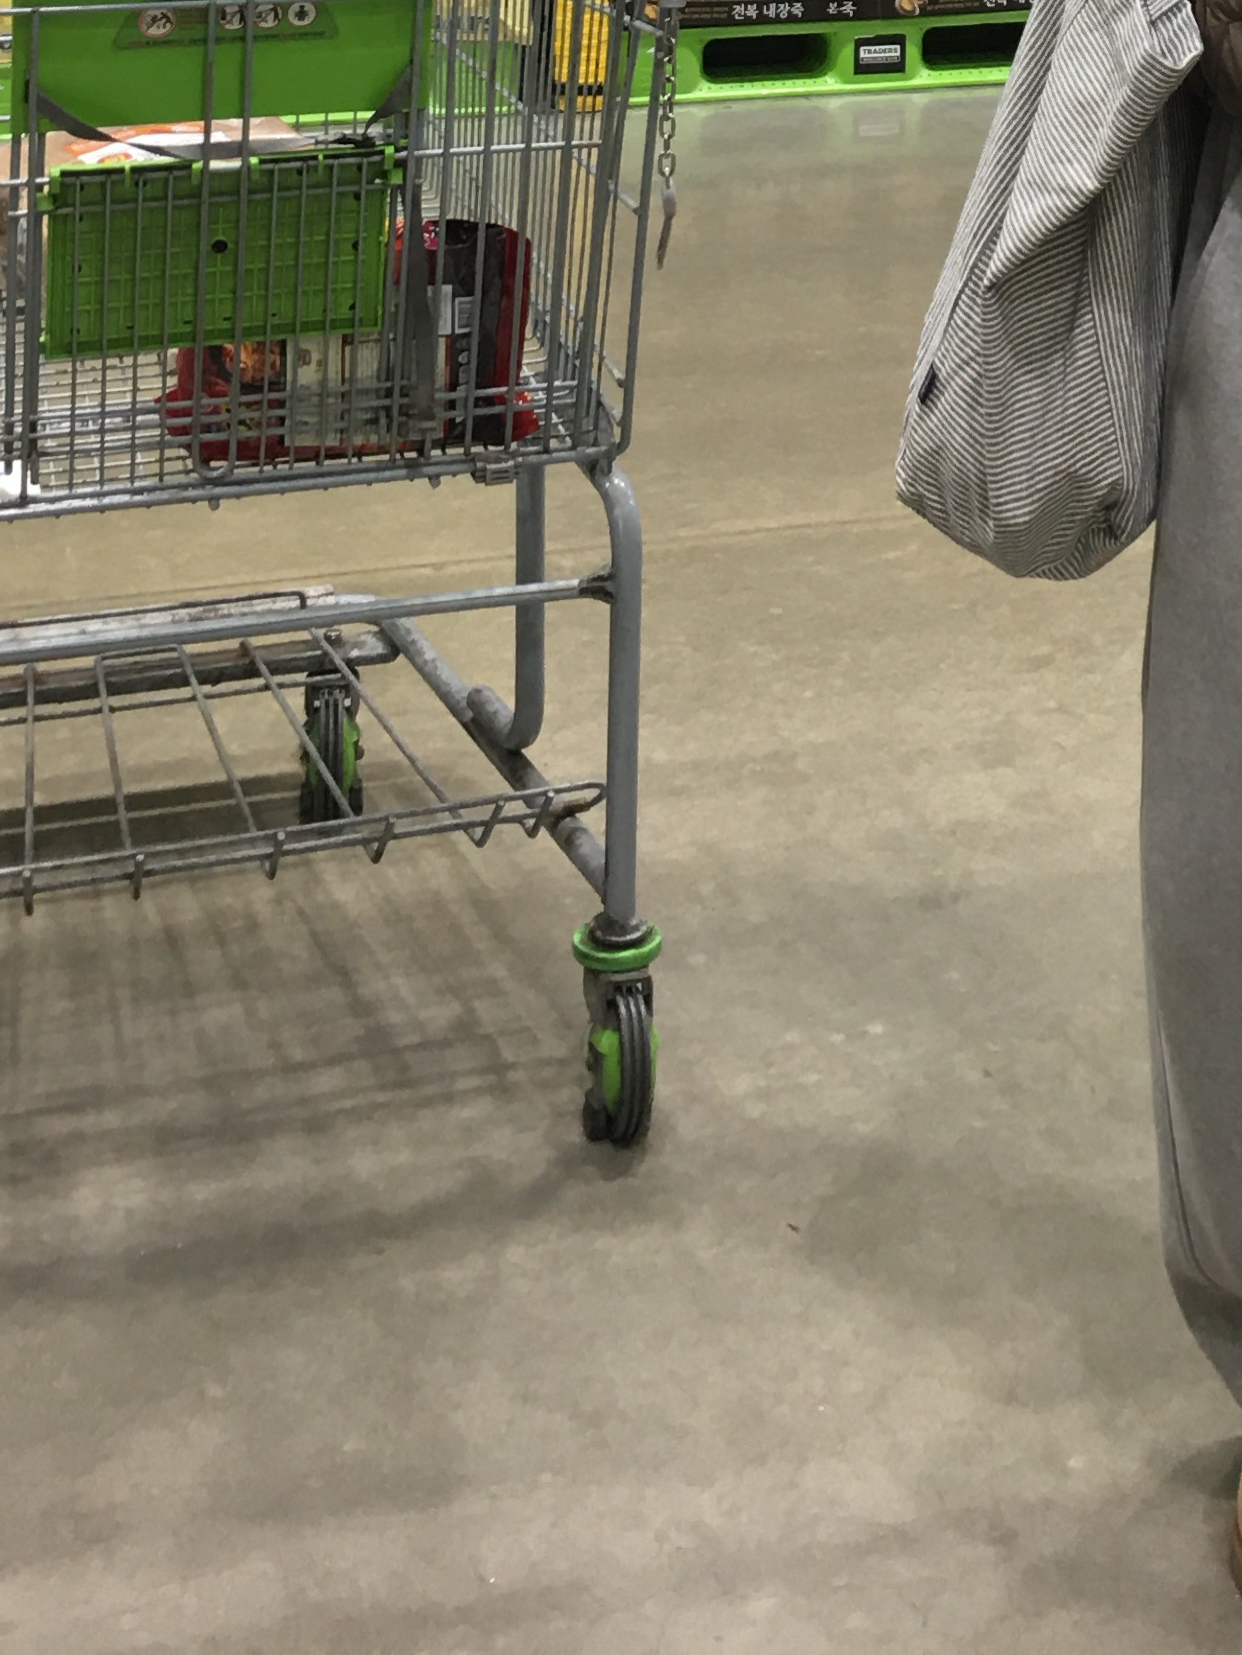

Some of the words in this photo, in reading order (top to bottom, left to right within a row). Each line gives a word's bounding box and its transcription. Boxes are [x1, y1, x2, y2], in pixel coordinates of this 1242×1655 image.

[731, 3, 760, 21] 전복
[763, 2, 805, 20] 내장죽
[826, 1, 858, 18] 본죽
[862, 47, 898, 57] TRADERS
